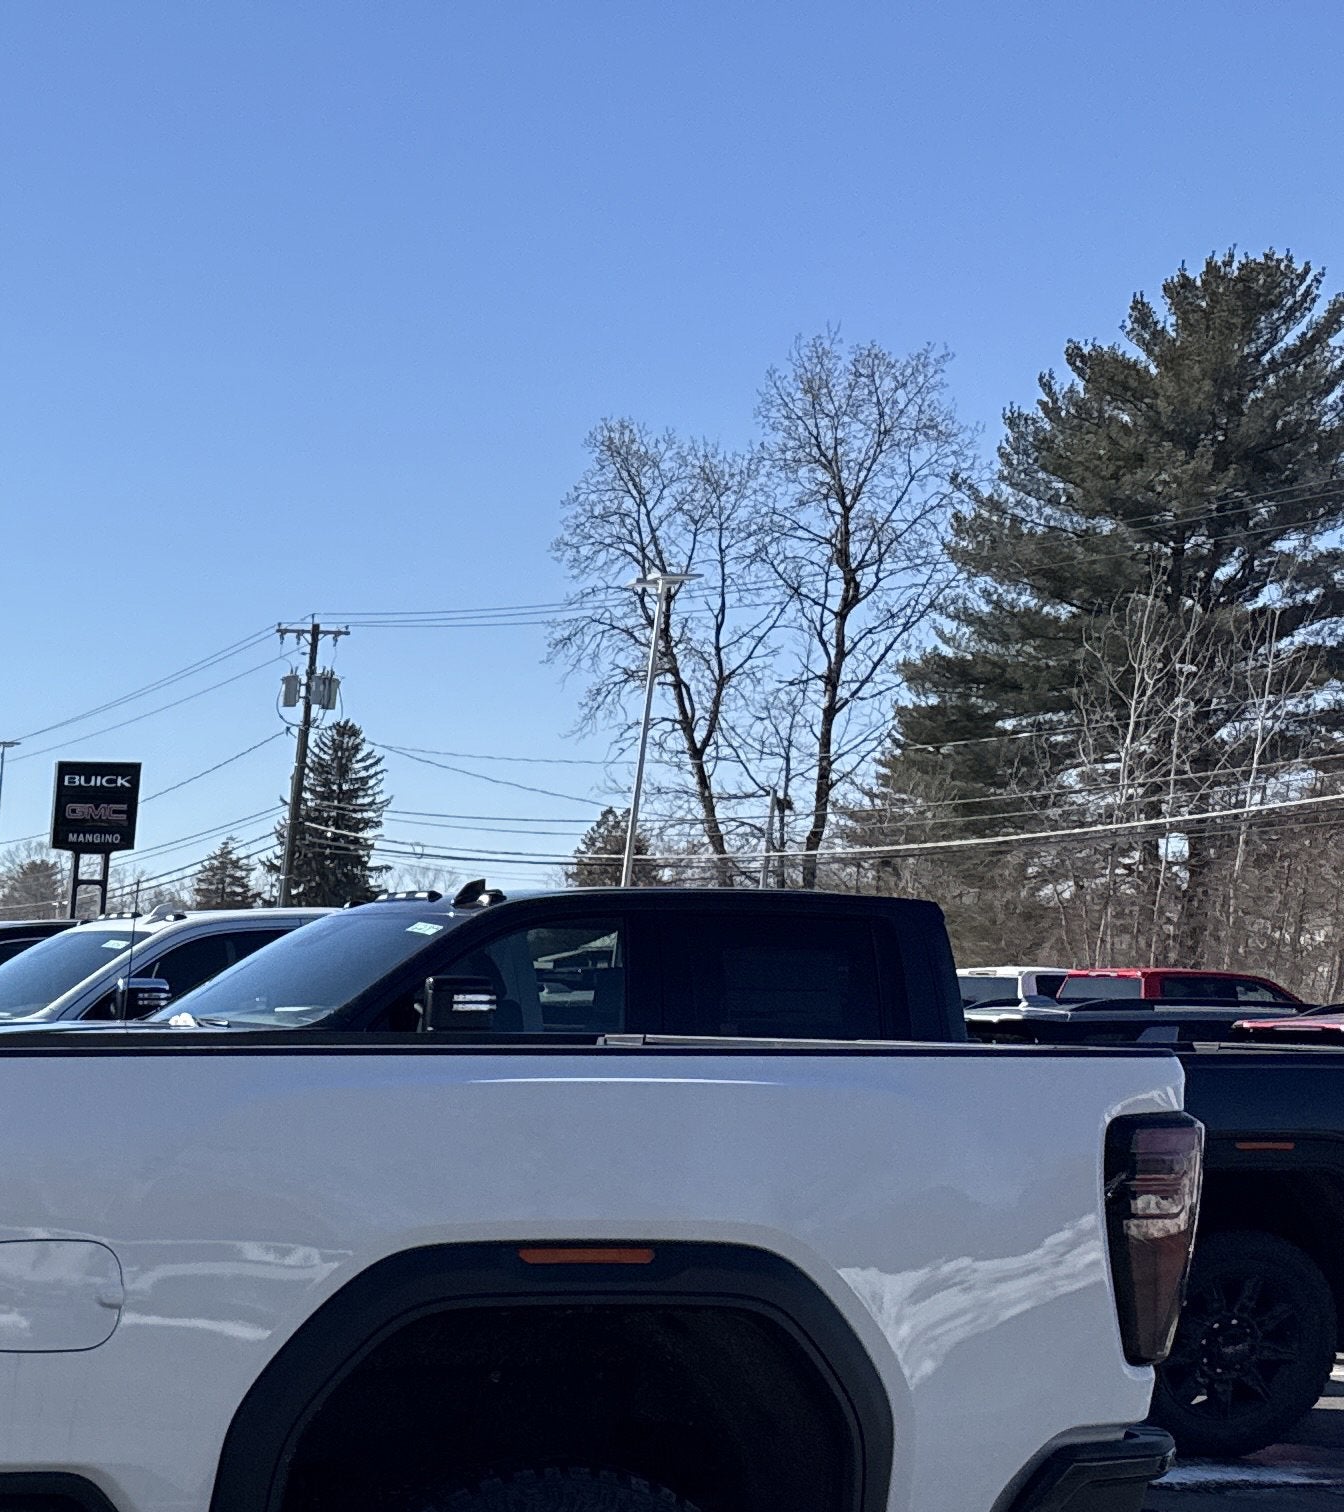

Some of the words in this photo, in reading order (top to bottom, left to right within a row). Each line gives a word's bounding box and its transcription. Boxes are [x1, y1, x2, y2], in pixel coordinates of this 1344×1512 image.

[64, 775, 132, 787] BUICK
[65, 803, 128, 820] GMC
[68, 833, 121, 843] MANGINO
